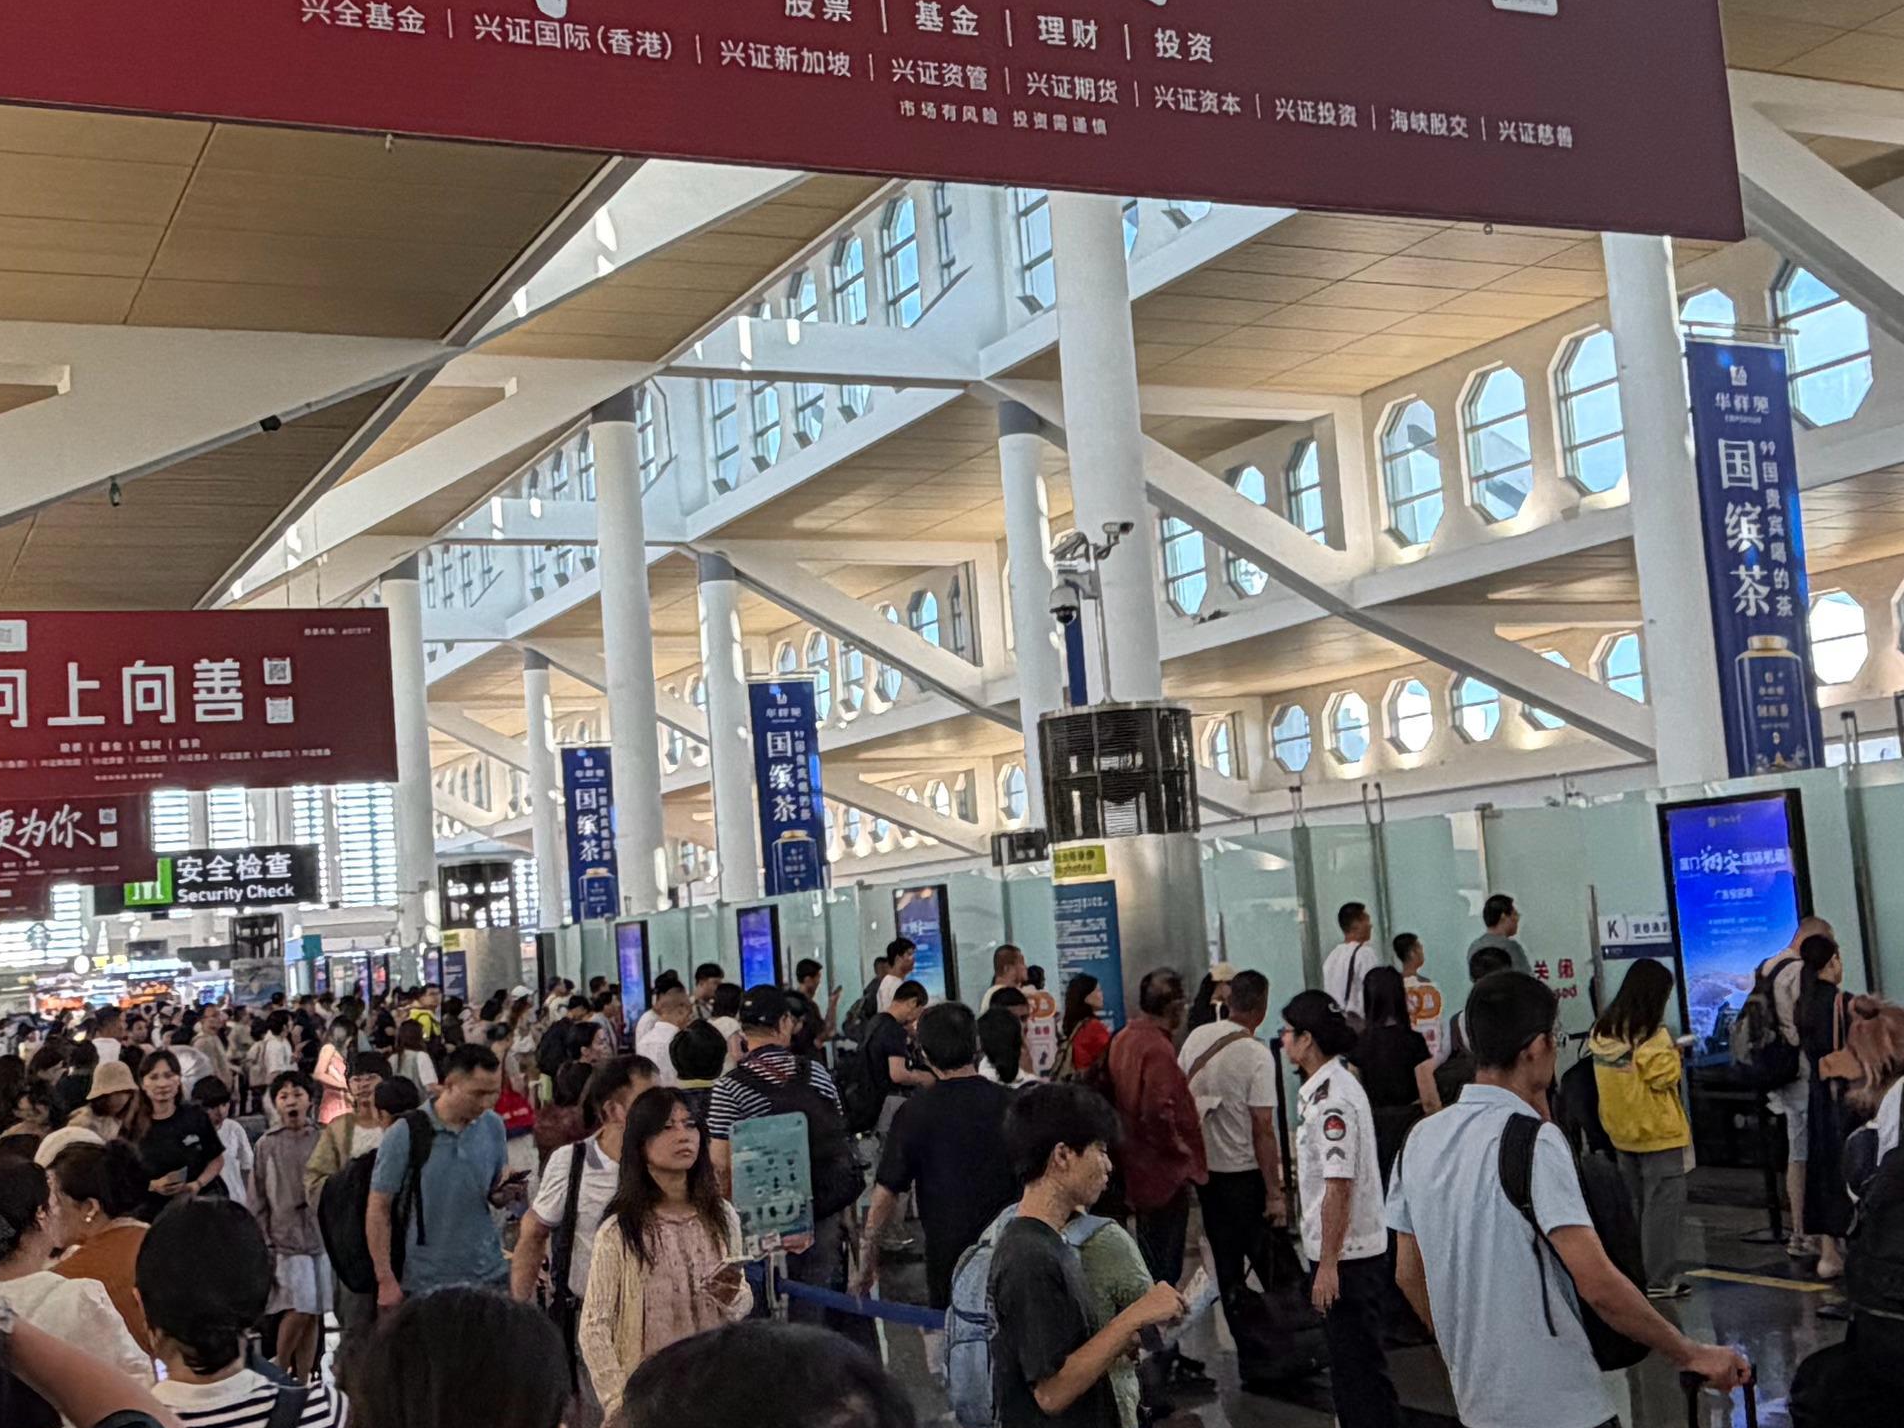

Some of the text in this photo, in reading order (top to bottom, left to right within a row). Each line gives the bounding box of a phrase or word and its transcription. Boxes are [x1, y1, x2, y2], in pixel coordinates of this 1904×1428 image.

[915, 0, 979, 36] 基金
[1037, 15, 1098, 50] 理财
[1154, 29, 1213, 63] 投资
[720, 41, 851, 78] 兴证新加坡
[891, 59, 988, 92] 兴证资管
[1026, 72, 1119, 104] 兴证期货
[1154, 85, 1241, 116] 兴证资本
[1275, 98, 1357, 128] 兴证投资
[1389, 109, 1469, 139] 海峡股交
[1498, 120, 1573, 149] 兴证慈善
[1718, 438, 1771, 617] 国缤茶
[176, 852, 293, 883] 安全检查
[177, 883, 296, 903] Security Check
[1607, 920, 1619, 939] K
